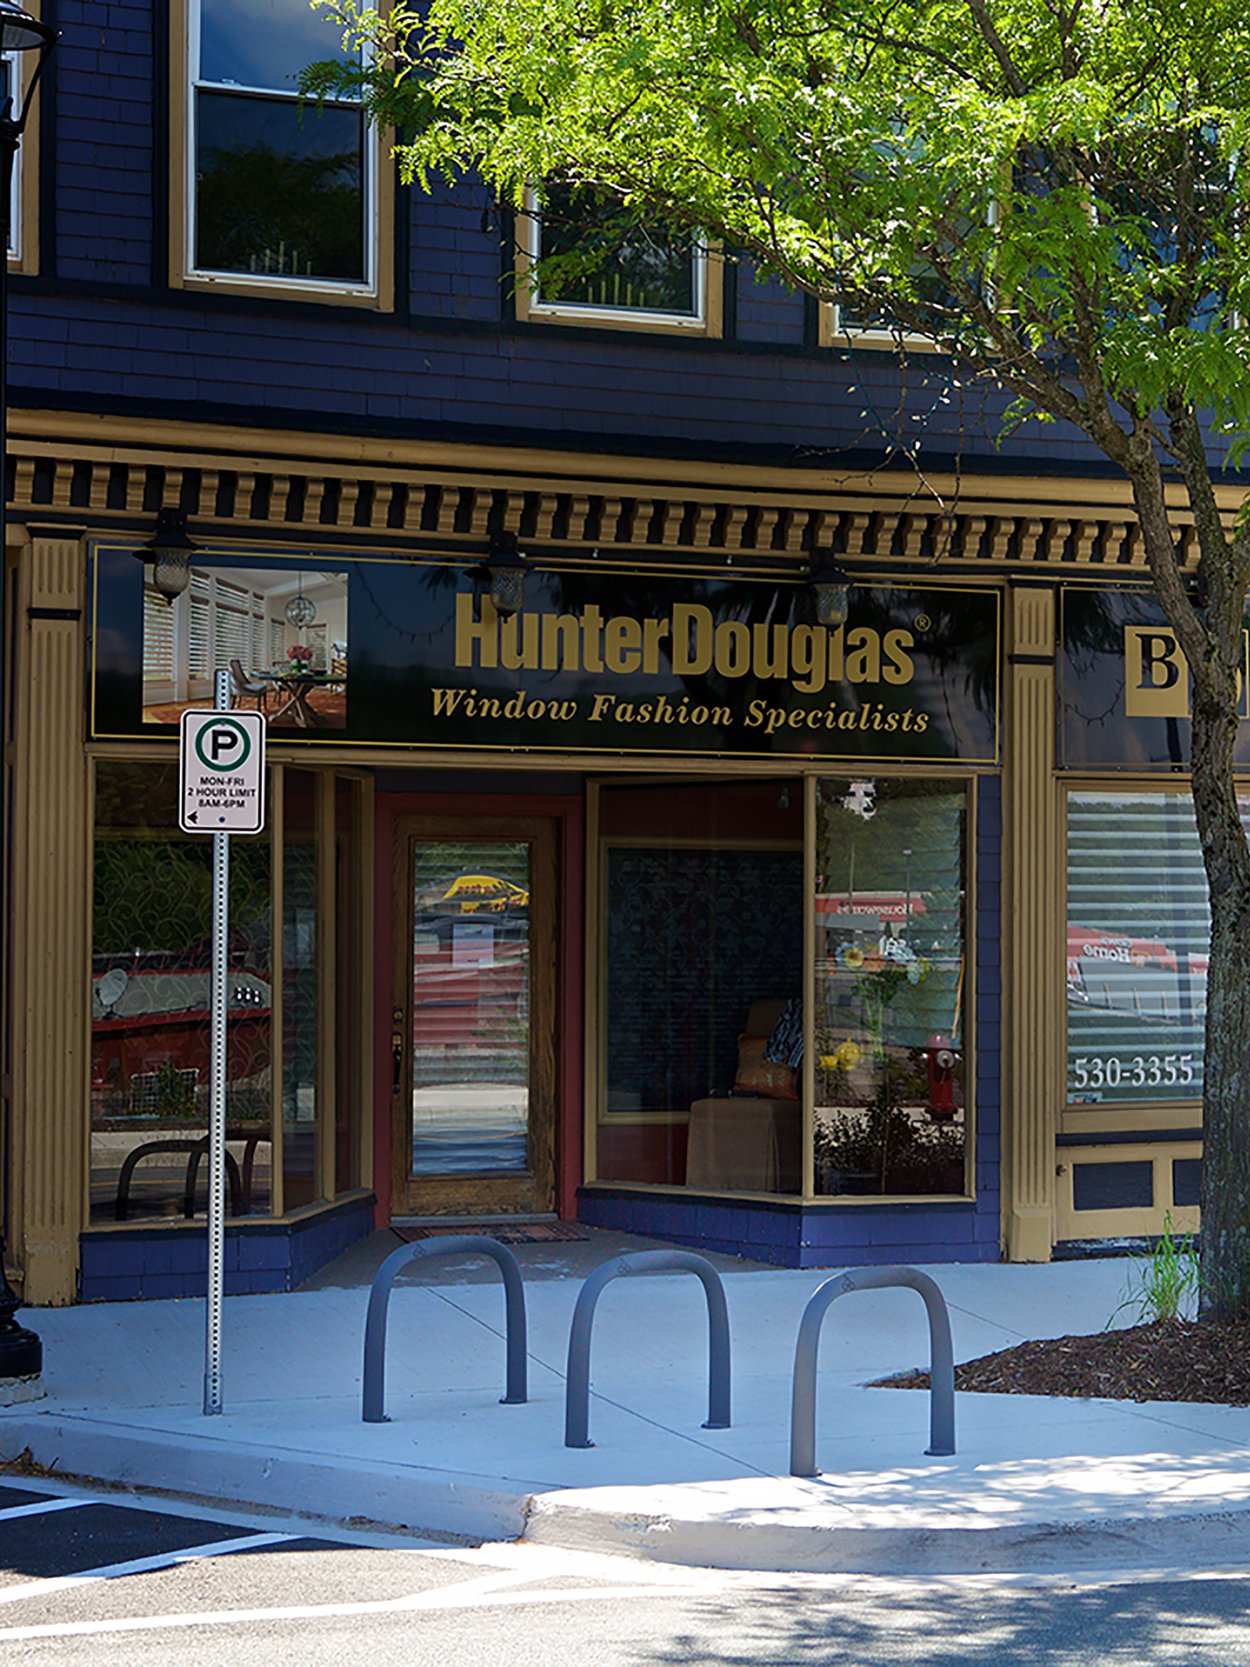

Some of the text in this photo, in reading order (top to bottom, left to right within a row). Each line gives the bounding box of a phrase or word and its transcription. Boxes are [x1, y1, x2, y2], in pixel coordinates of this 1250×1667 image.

[431, 688, 930, 734] Window Fashion Specialists
[211, 729, 238, 760] P
[187, 787, 256, 797] 2 HOUR LIMIT
[200, 776, 245, 786] MON-FRI
[1074, 1053, 1193, 1089] 530-3355
